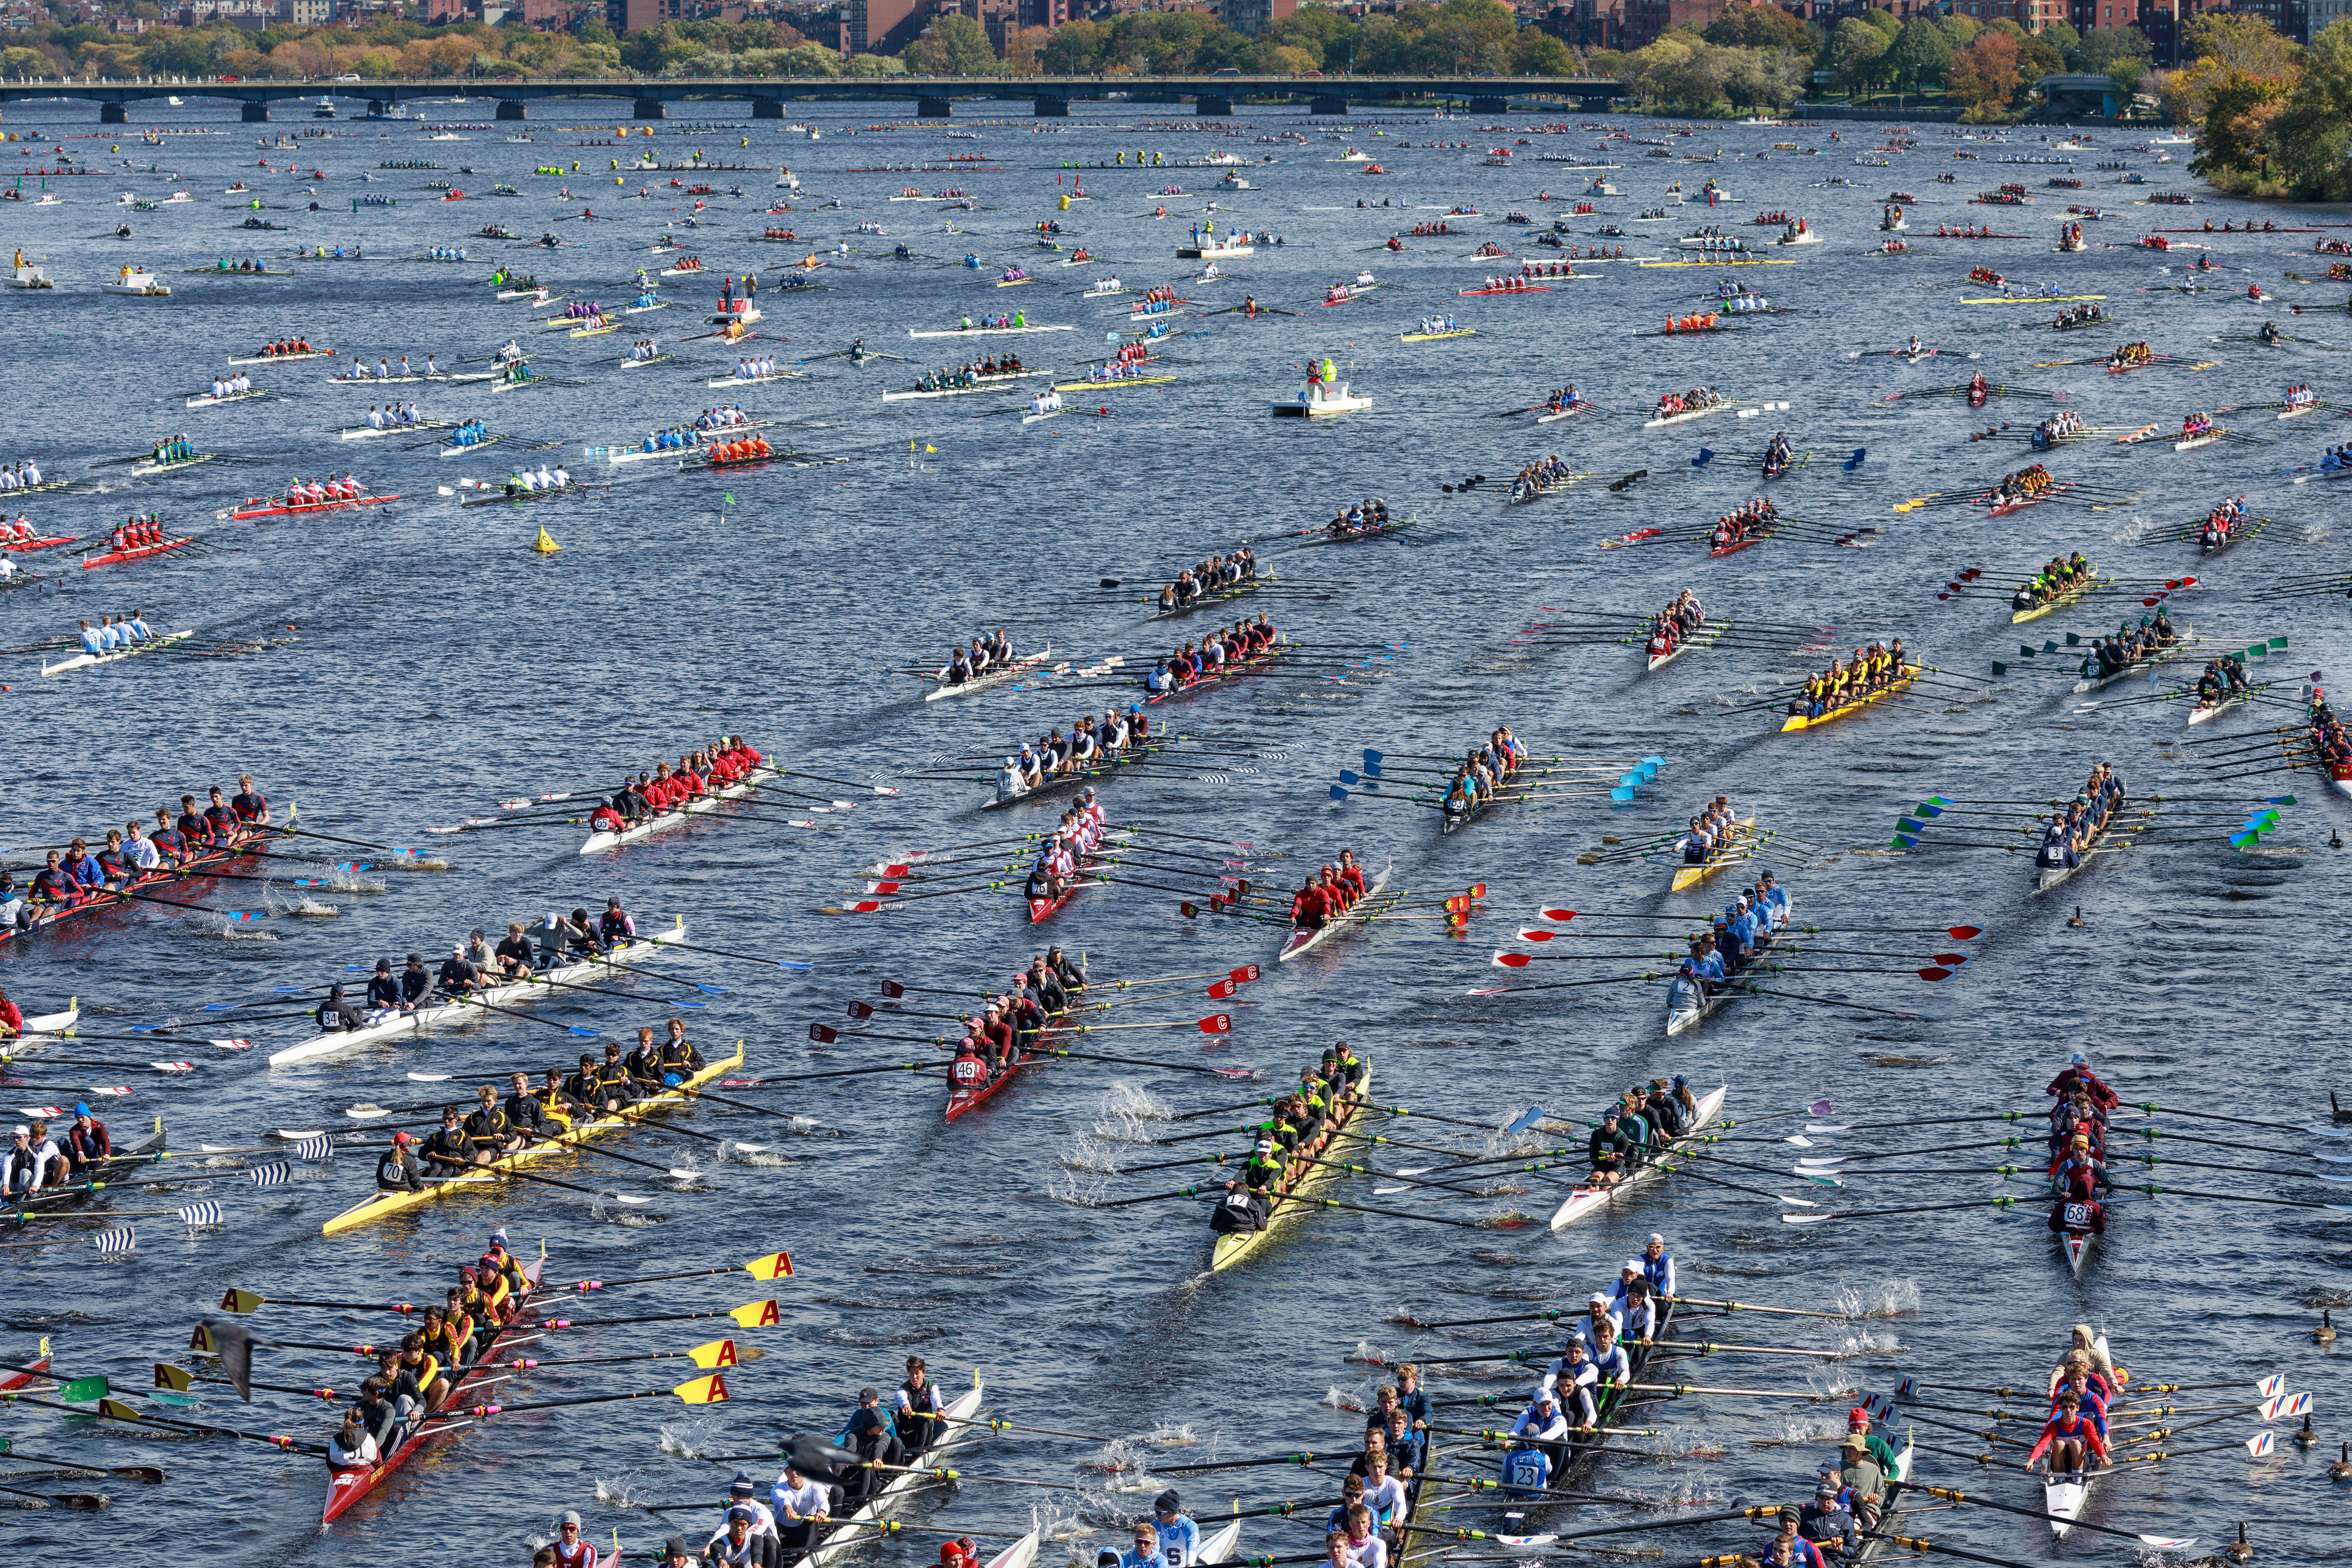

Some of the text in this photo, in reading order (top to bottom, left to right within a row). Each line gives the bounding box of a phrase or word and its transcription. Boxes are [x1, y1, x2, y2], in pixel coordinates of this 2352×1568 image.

[542, 536, 549, 546] S
[90, 635, 97, 643] 18
[2090, 666, 2098, 674] 45
[597, 819, 606, 827] 65
[2053, 848, 2059, 858] 3
[1035, 884, 1045, 893] 76
[39, 915, 55, 925] RESOLUTE
[1248, 966, 1257, 979] C
[884, 982, 891, 994] C
[1224, 981, 1234, 994] C
[1683, 982, 1688, 991] 2
[850, 1002, 858, 1015] C
[325, 1012, 336, 1024] 34
[1217, 1016, 1227, 1029] C
[813, 1025, 821, 1039] C
[958, 1063, 973, 1075] 46
[385, 1164, 400, 1179] 70
[1229, 1195, 1245, 1204] 17
[2067, 1205, 2084, 1222] 68
[773, 1252, 793, 1278] A
[220, 1287, 238, 1312] A
[759, 1299, 780, 1326] A
[189, 1325, 208, 1351] A
[716, 1340, 737, 1366] A
[155, 1363, 175, 1389] A
[707, 1374, 730, 1402] A
[1516, 1467, 1534, 1485] 23
[1167, 1548, 1181, 1566] S
